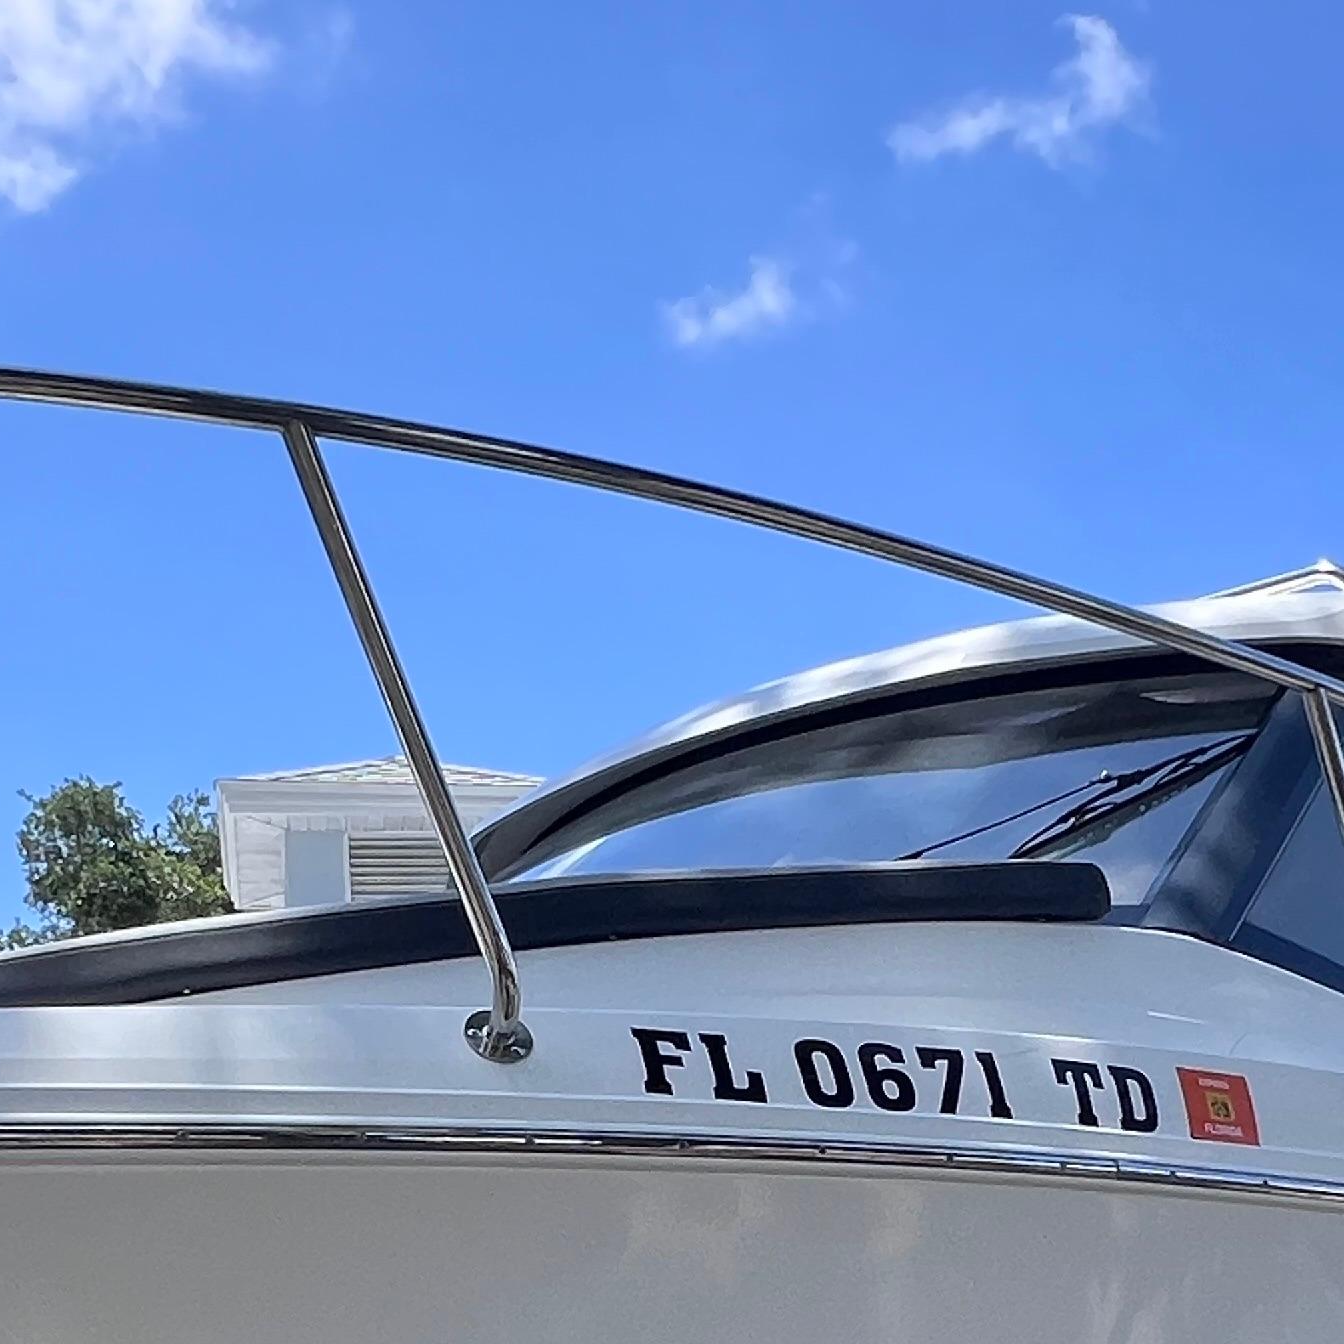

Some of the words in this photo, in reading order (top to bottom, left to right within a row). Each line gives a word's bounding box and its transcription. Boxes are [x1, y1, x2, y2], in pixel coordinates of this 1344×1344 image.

[630, 1027, 768, 1104] FL
[793, 1038, 1015, 1121] 0671
[1049, 1057, 1159, 1134] TD
